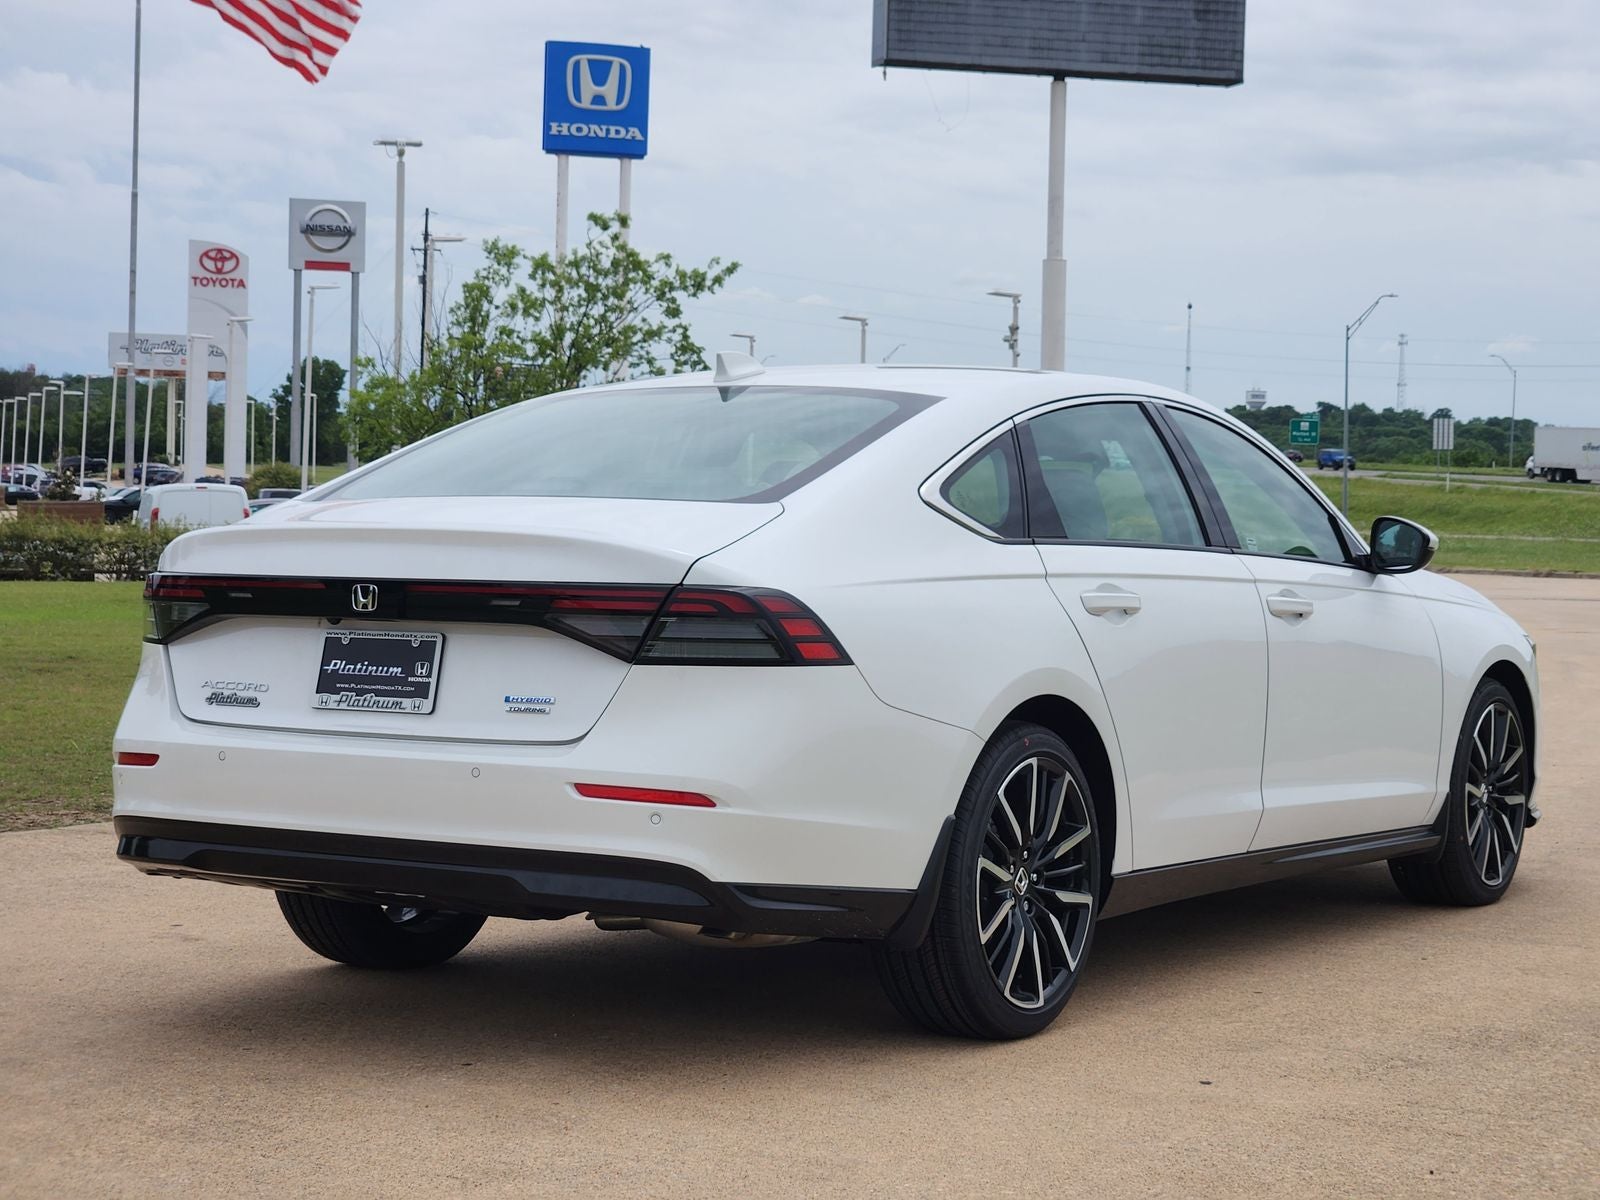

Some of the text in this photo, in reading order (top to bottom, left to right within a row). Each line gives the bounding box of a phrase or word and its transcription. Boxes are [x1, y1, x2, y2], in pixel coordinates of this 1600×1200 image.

[549, 122, 645, 141] HONDA
[305, 223, 352, 233] NISSAN
[191, 276, 247, 289] TOYOTA
[323, 660, 406, 677] Platinum
[201, 680, 270, 693] ACCORD
[205, 691, 261, 708] Platinum
[334, 692, 408, 710] Platinum
[511, 696, 552, 704] HYBRID
